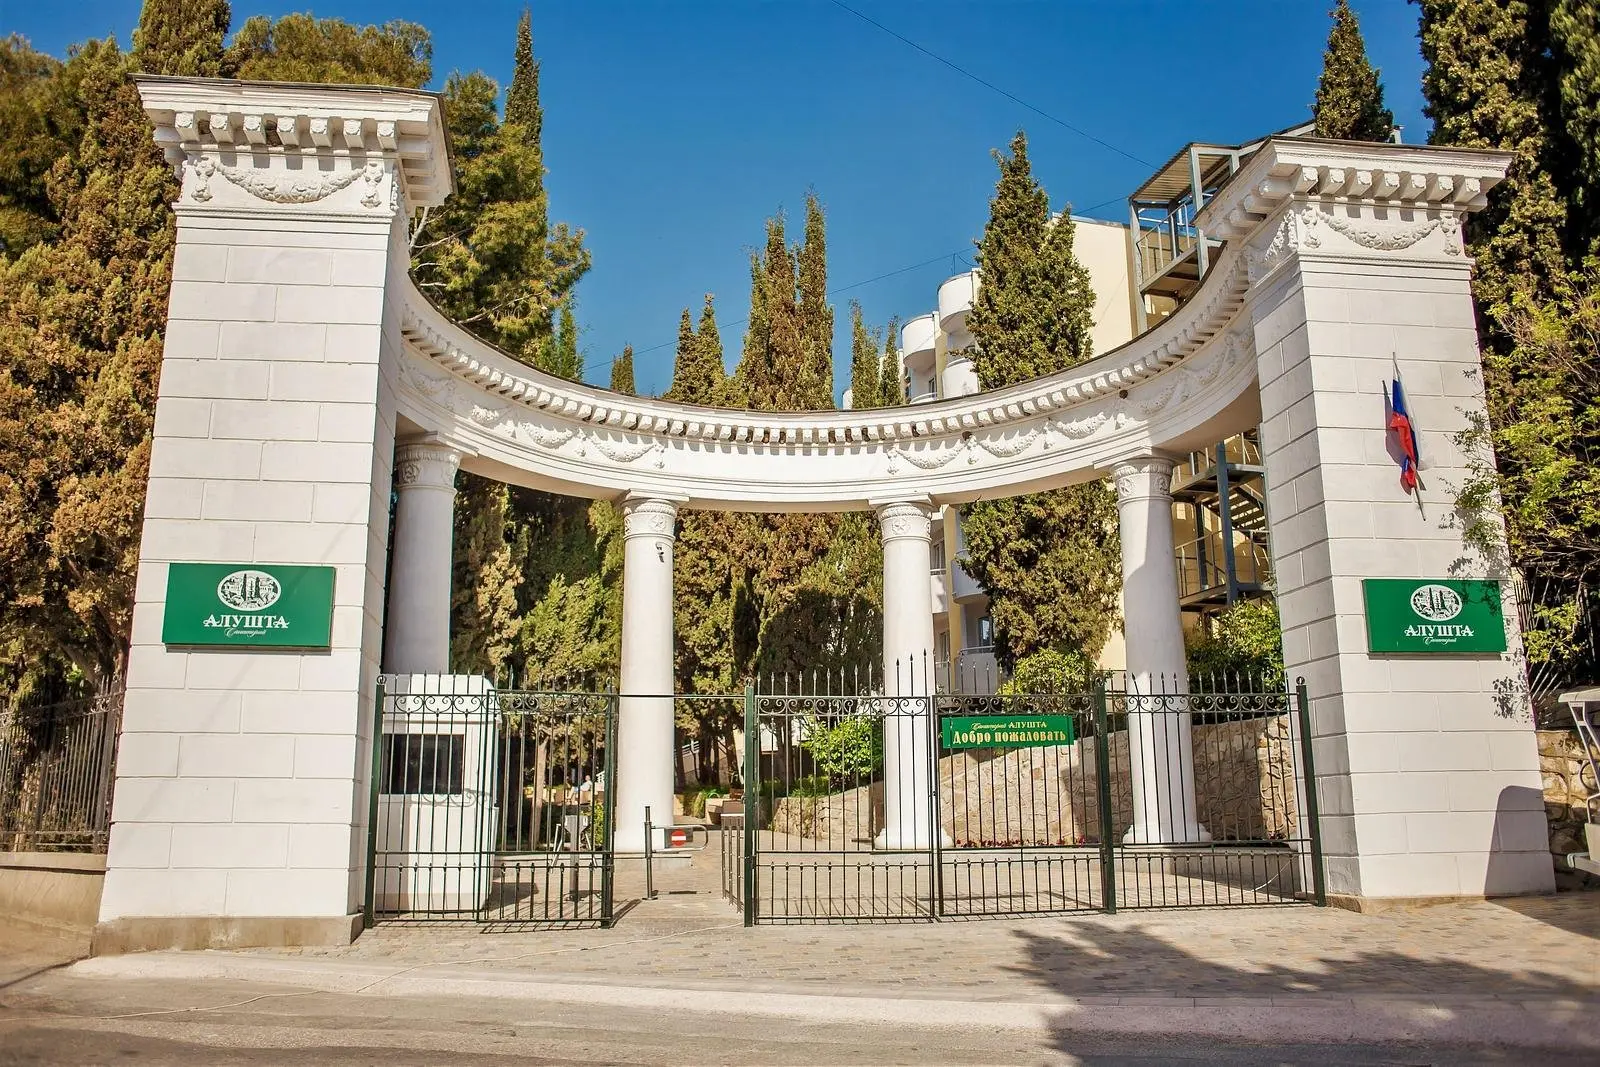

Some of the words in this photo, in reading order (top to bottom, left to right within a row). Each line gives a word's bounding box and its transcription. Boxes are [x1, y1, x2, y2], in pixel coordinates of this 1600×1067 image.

[203, 614, 290, 629] АЛУШТА
[1404, 624, 1475, 637] АЛУШТА
[1008, 721, 1047, 729] АЛУШТА
[953, 731, 991, 745] Добро
[994, 731, 1066, 742] пожаловать
